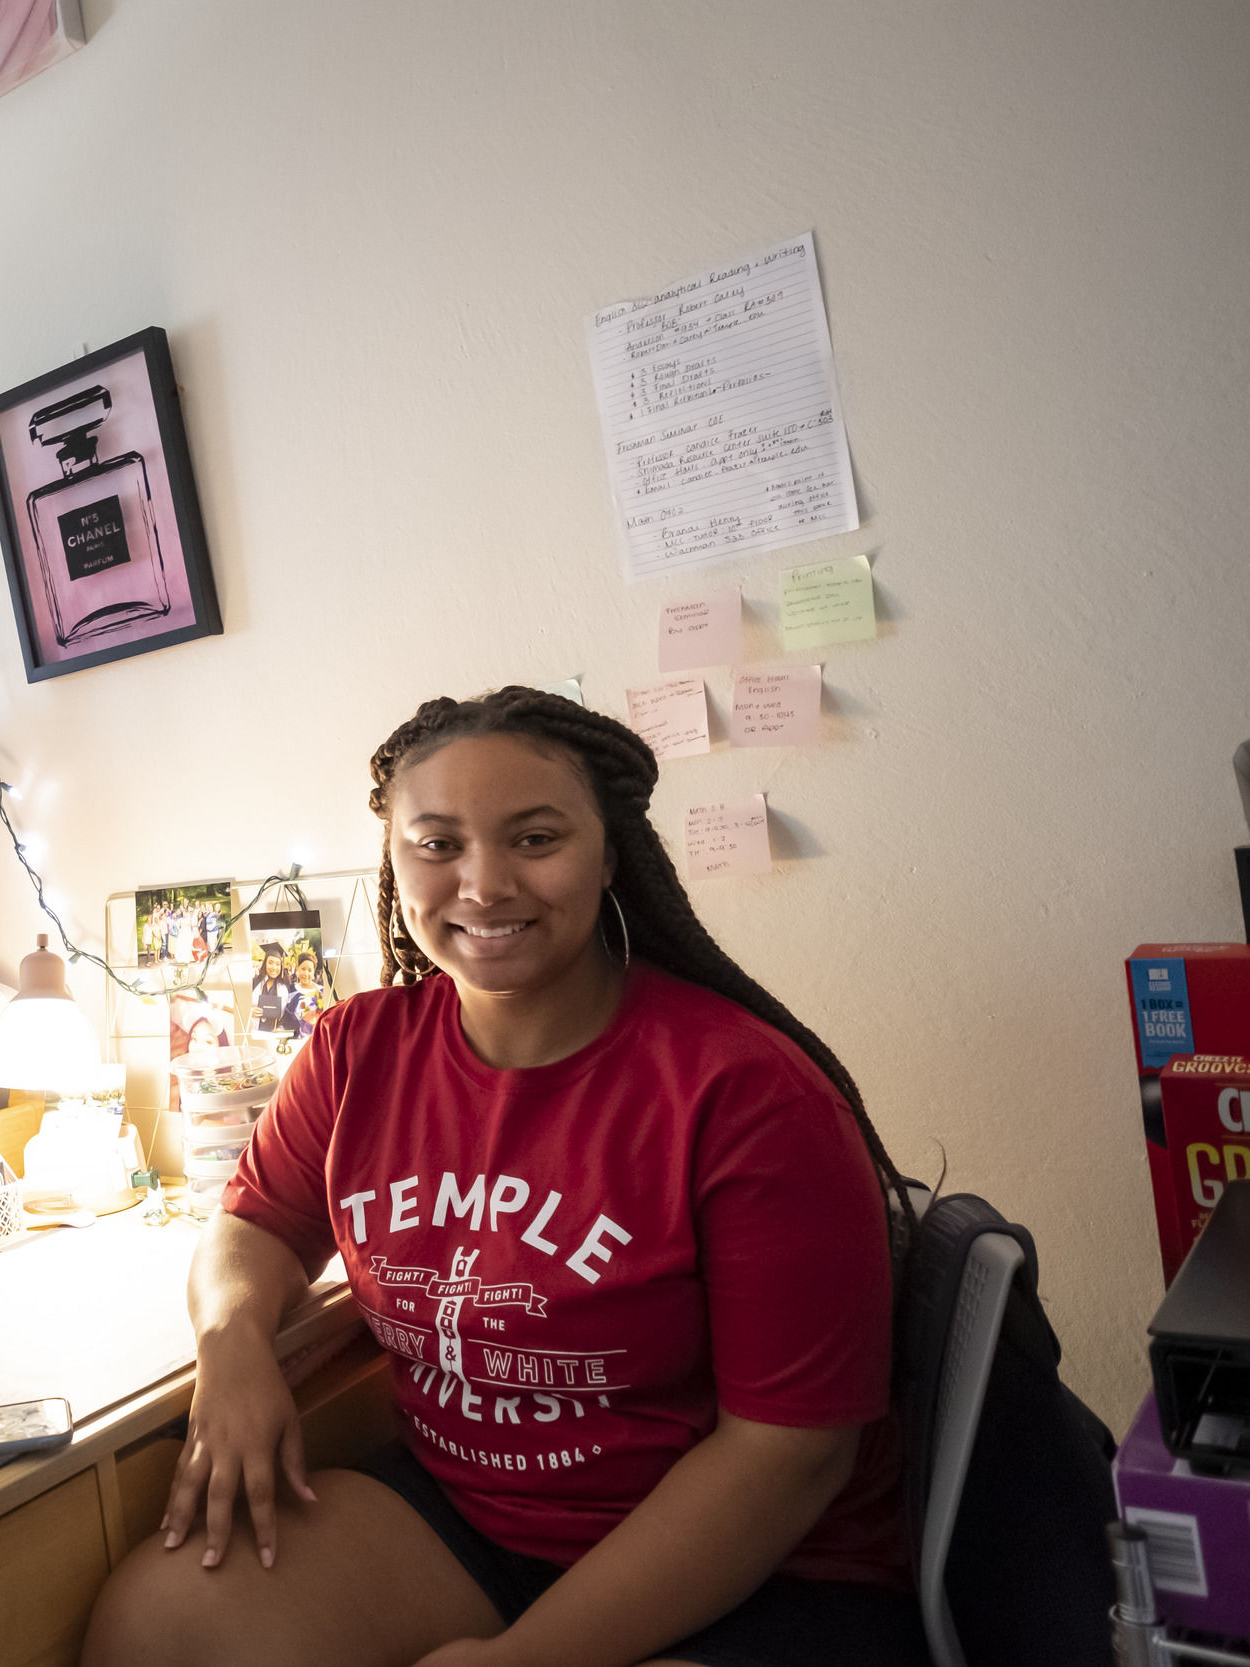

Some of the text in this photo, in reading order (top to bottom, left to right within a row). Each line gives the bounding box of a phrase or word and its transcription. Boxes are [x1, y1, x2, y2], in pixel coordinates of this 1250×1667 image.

[764, 244, 806, 265] Writing
[67, 521, 121, 548] CHANEL
[1149, 999, 1173, 1010] BOX
[1151, 1010, 1185, 1023] FREE
[1145, 1023, 1187, 1038] BOOK
[340, 1171, 633, 1285] TEMPLE
[385, 1269, 522, 1302] FIGHT! FIGHT! FIGHT!
[396, 1299, 505, 1331] FOR THE
[444, 1345, 457, 1362] &
[483, 1348, 608, 1385] WHITE
[414, 1415, 585, 1471] ESTABLISHED 1884
